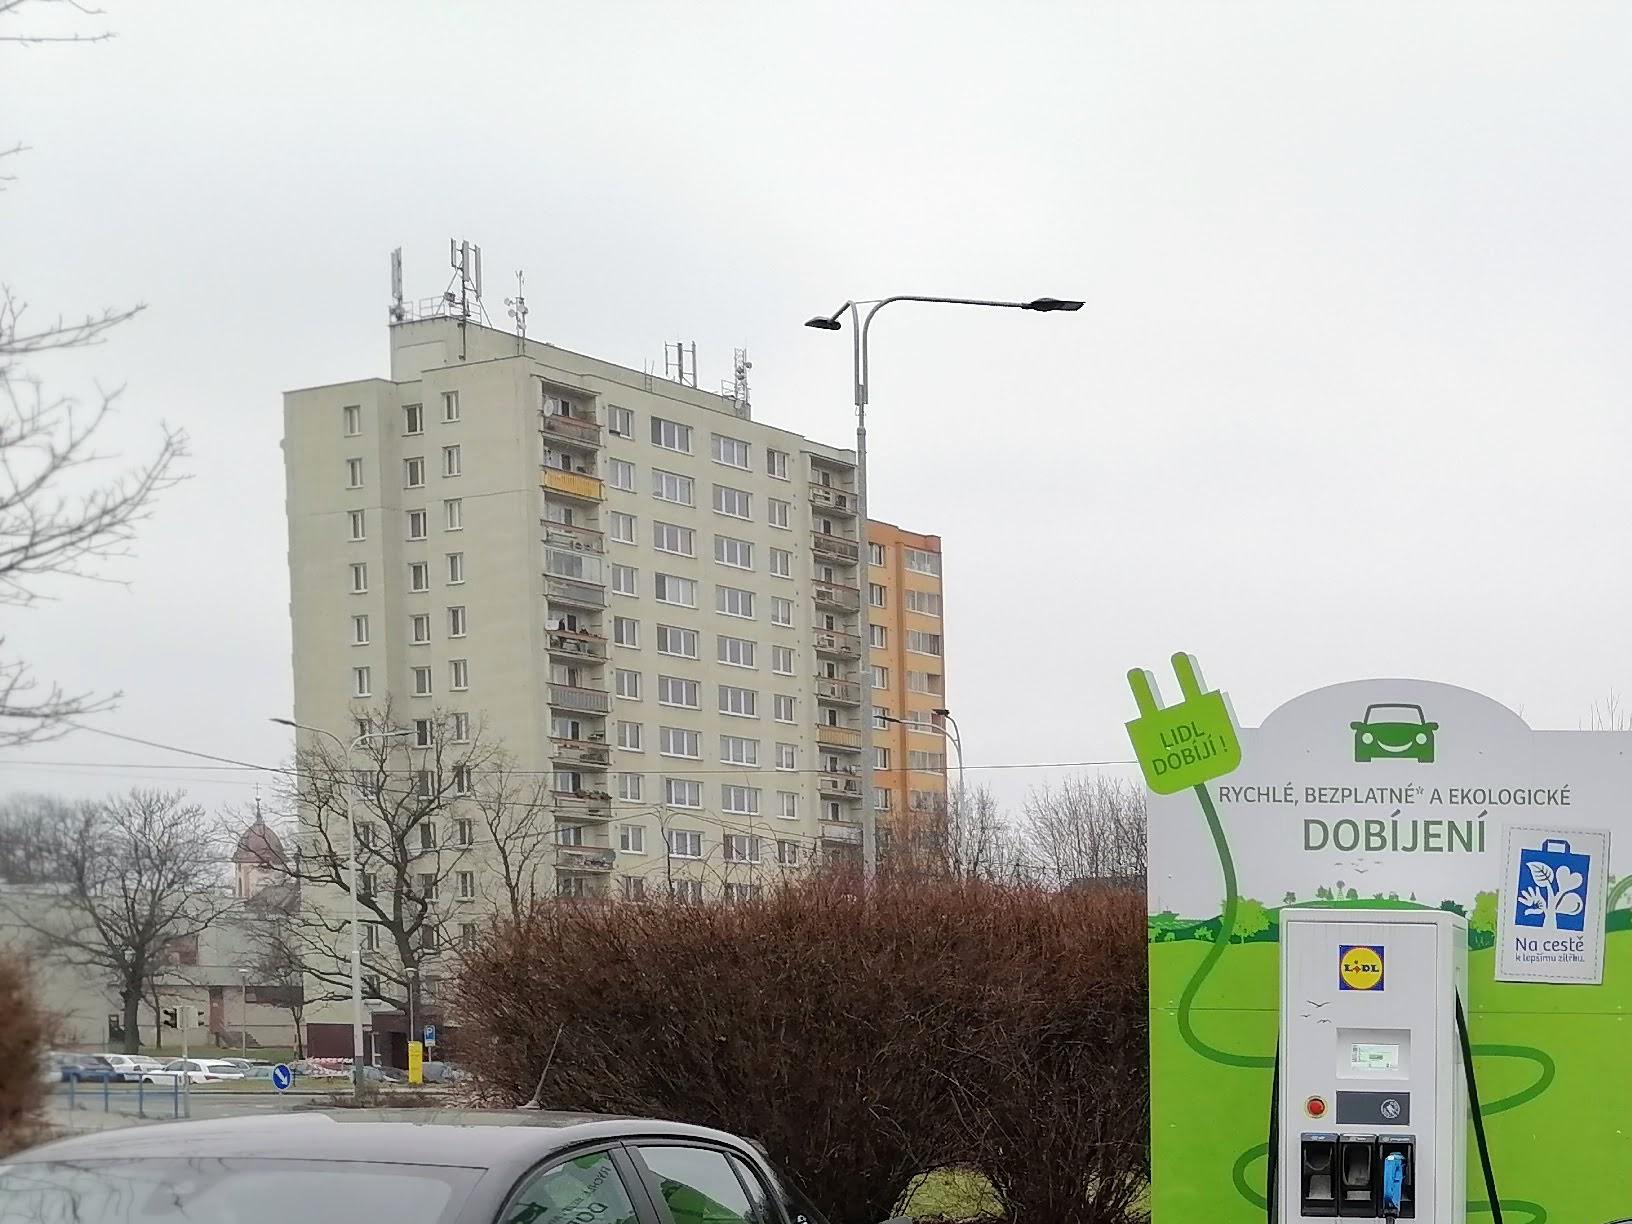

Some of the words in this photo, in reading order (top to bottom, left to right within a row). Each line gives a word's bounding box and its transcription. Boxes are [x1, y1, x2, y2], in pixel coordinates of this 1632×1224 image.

[1160, 721, 1205, 748] LIDL
[1151, 734, 1217, 776] DOBÍJÍ
[1219, 782, 1299, 806] RYCHLÉ,
[1429, 789, 1443, 804] A
[1450, 784, 1571, 805] EKOLOGICKÉ
[1303, 809, 1488, 852] DOBÍJENÍ
[1515, 937, 1538, 951] Na
[1543, 935, 1585, 951] cestě
[1515, 952, 1521, 962] k
[1522, 952, 1557, 963] lepšímu
